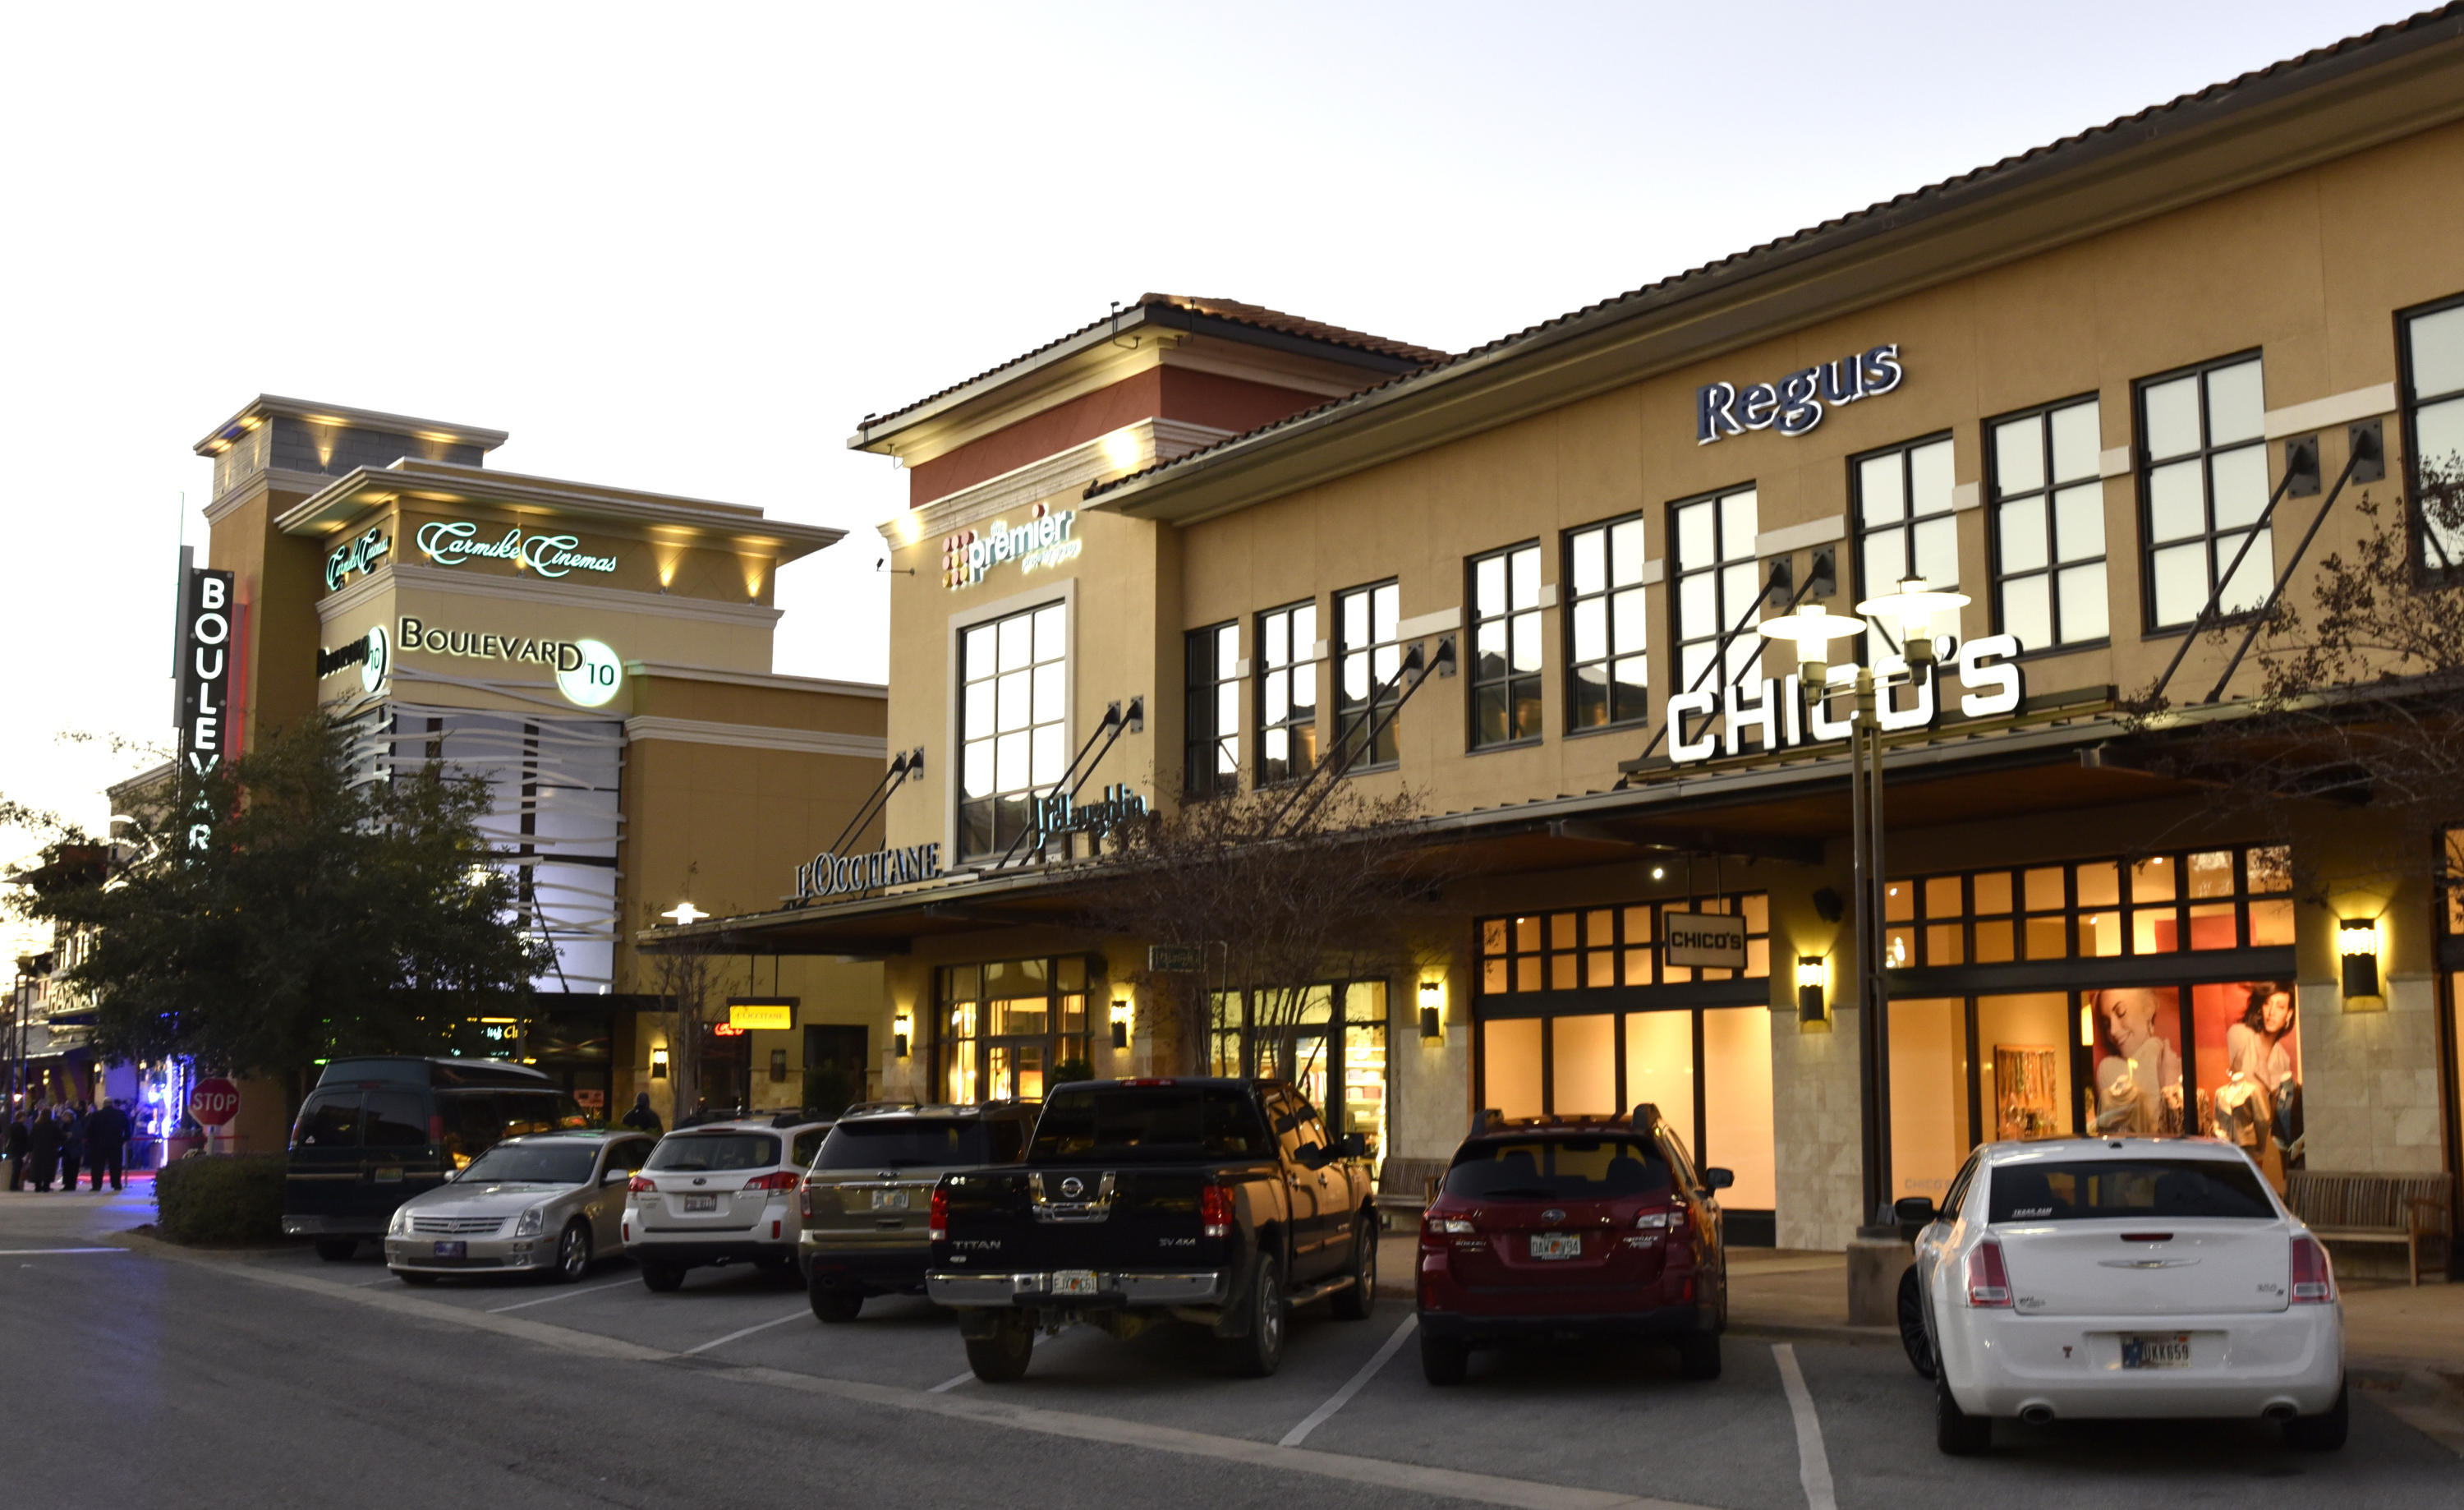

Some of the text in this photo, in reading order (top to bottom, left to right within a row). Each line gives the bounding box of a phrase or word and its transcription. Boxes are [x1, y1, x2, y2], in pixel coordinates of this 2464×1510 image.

[1695, 343, 1903, 445] Regus
[416, 522, 617, 578] Carmike Cinemas
[968, 503, 1070, 583] premier
[399, 615, 584, 673] BOULEVARD
[587, 661, 614, 687] 10
[1667, 633, 2025, 762] CHICO'S
[1671, 931, 1742, 950] CHICO'S
[192, 1092, 237, 1112] STOP
[952, 1239, 1002, 1250] TITAN
